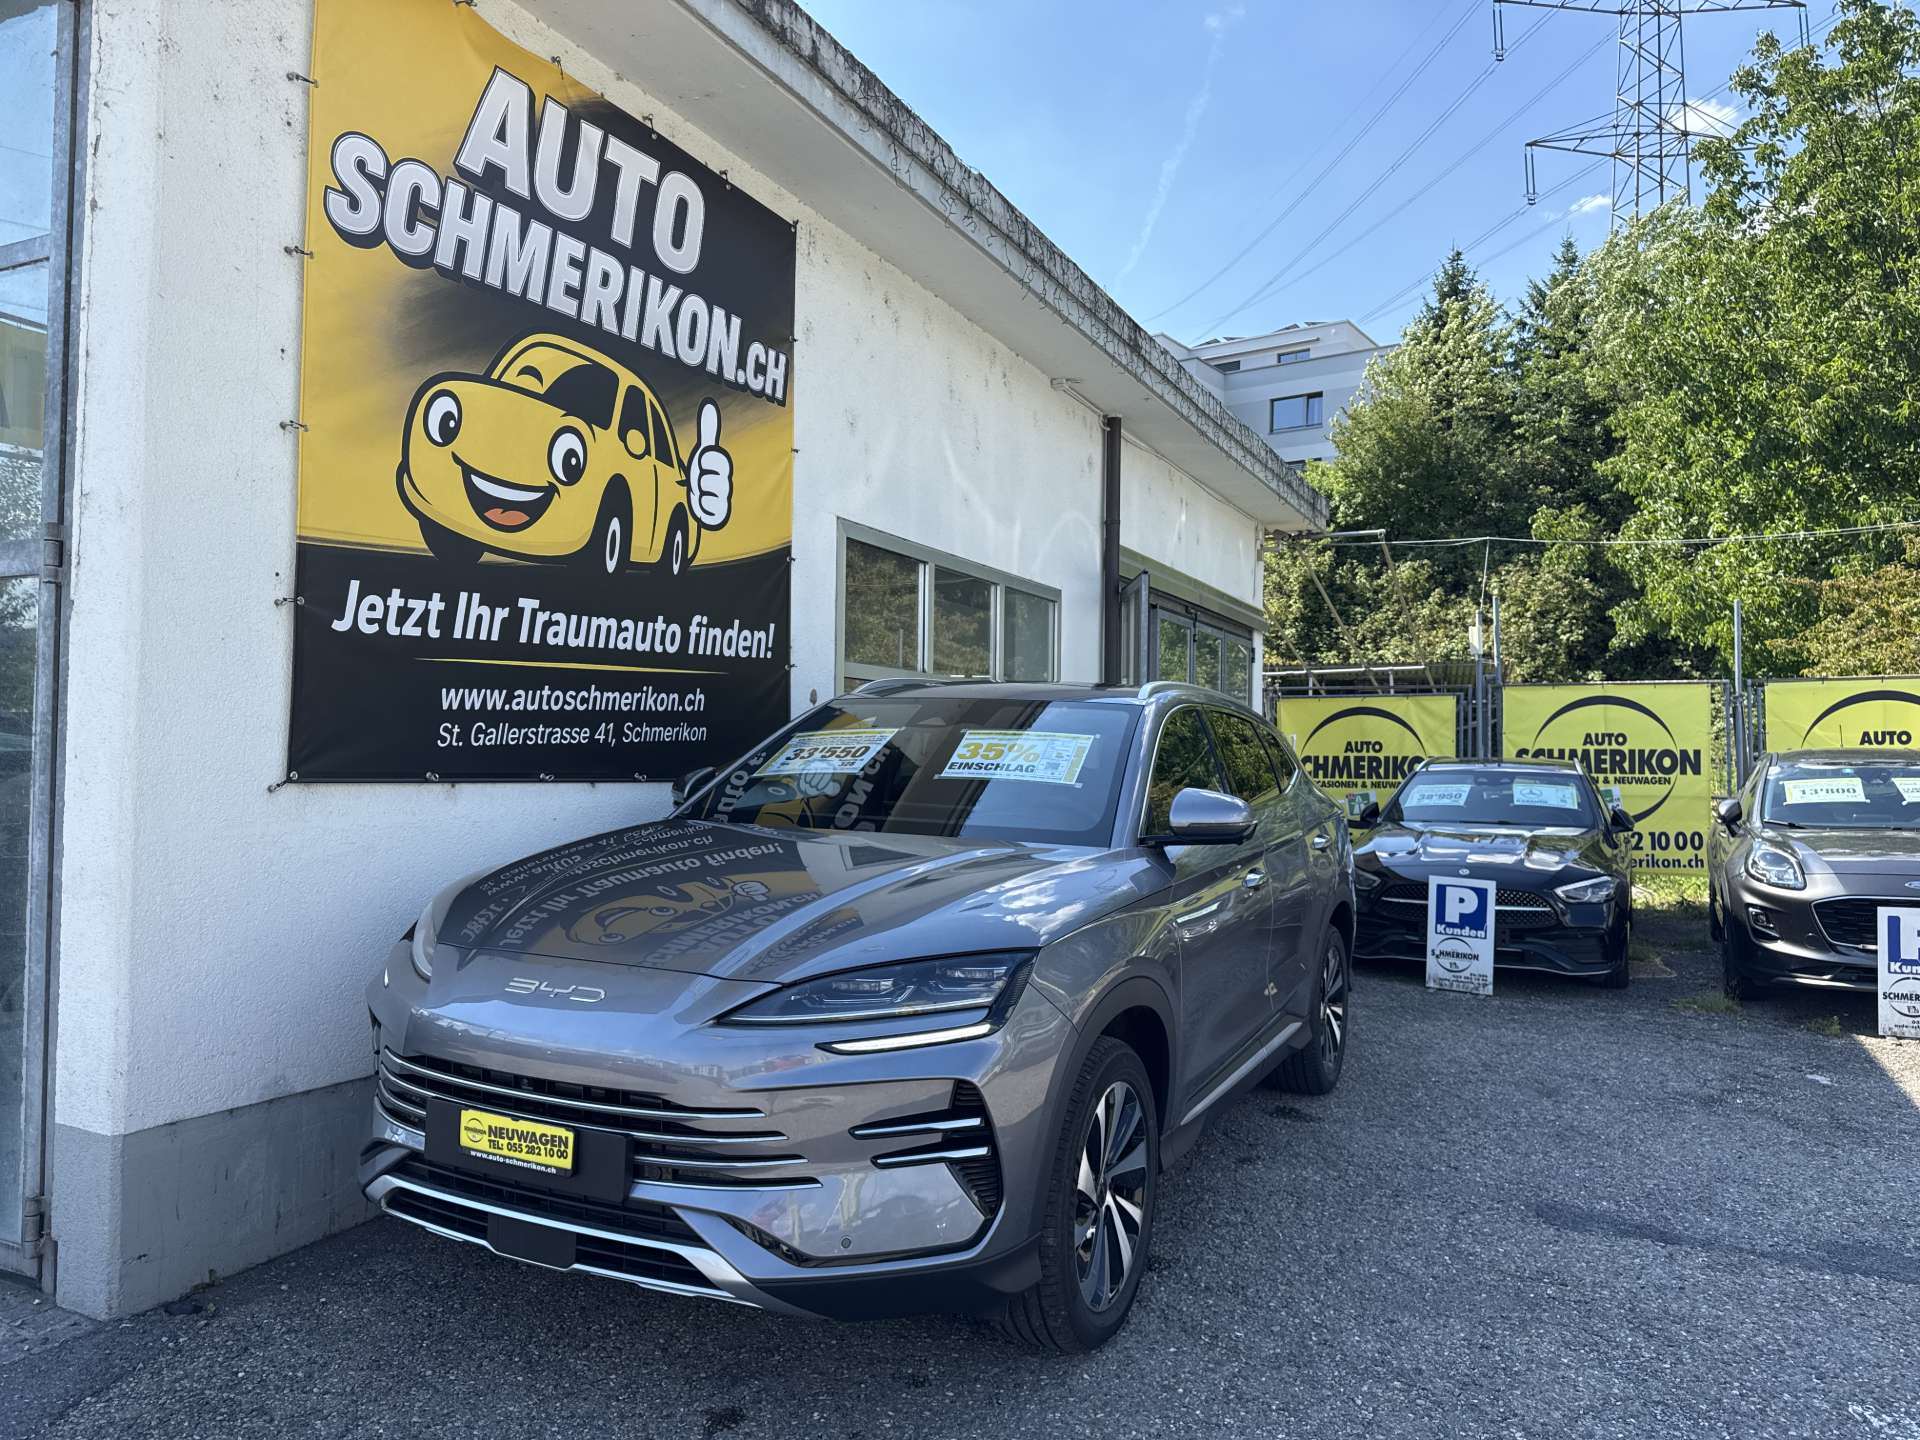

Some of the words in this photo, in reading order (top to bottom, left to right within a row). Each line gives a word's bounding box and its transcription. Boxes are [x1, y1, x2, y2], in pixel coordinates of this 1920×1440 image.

[453, 66, 706, 275] AUTO
[324, 132, 788, 403] SCHMERIKON.CH
[331, 579, 445, 638] Jetzt
[453, 591, 509, 642] Ihr
[517, 598, 681, 654] Traumauto
[687, 614, 775, 659] finden!
[441, 685, 705, 712] www.autoschmerikon.ch
[437, 723, 463, 746] St.
[471, 723, 590, 746] Gallerstrasse
[594, 723, 616, 747] 41,
[622, 722, 707, 743] Schmerikon
[1582, 733, 1628, 746] AUTO
[1859, 731, 1913, 746] AUTO
[785, 746, 871, 762] 33'550
[956, 741, 1041, 763] 35%
[1343, 741, 1384, 754] AUTO
[947, 762, 1037, 774] EINSCHLAG
[1315, 780, 1358, 789] CASIONEN
[1361, 781, 1368, 789] &
[1371, 780, 1400, 789] NEUWA
[1613, 776, 1671, 785] NEUWAGEN
[1674, 831, 1704, 850] 00
[1631, 853, 1704, 869] erikon.ch
[1445, 886, 1479, 923] P
[1436, 924, 1486, 938] Kunden
[1431, 949, 1479, 961] SHMERIKON
[1890, 961, 1920, 974] Kun
[504, 977, 607, 1003] BYD
[1882, 991, 1920, 1001] SCHMER
[487, 1125, 569, 1149] NEUWAGEN
[488, 1139, 504, 1151] TEL:
[506, 1141, 523, 1154] 055
[525, 1145, 541, 1157] 282
[544, 1147, 555, 1158] 10
[556, 1149, 568, 1160] 00
[470, 1150, 557, 1174] www.auto-schmerikon.ch
